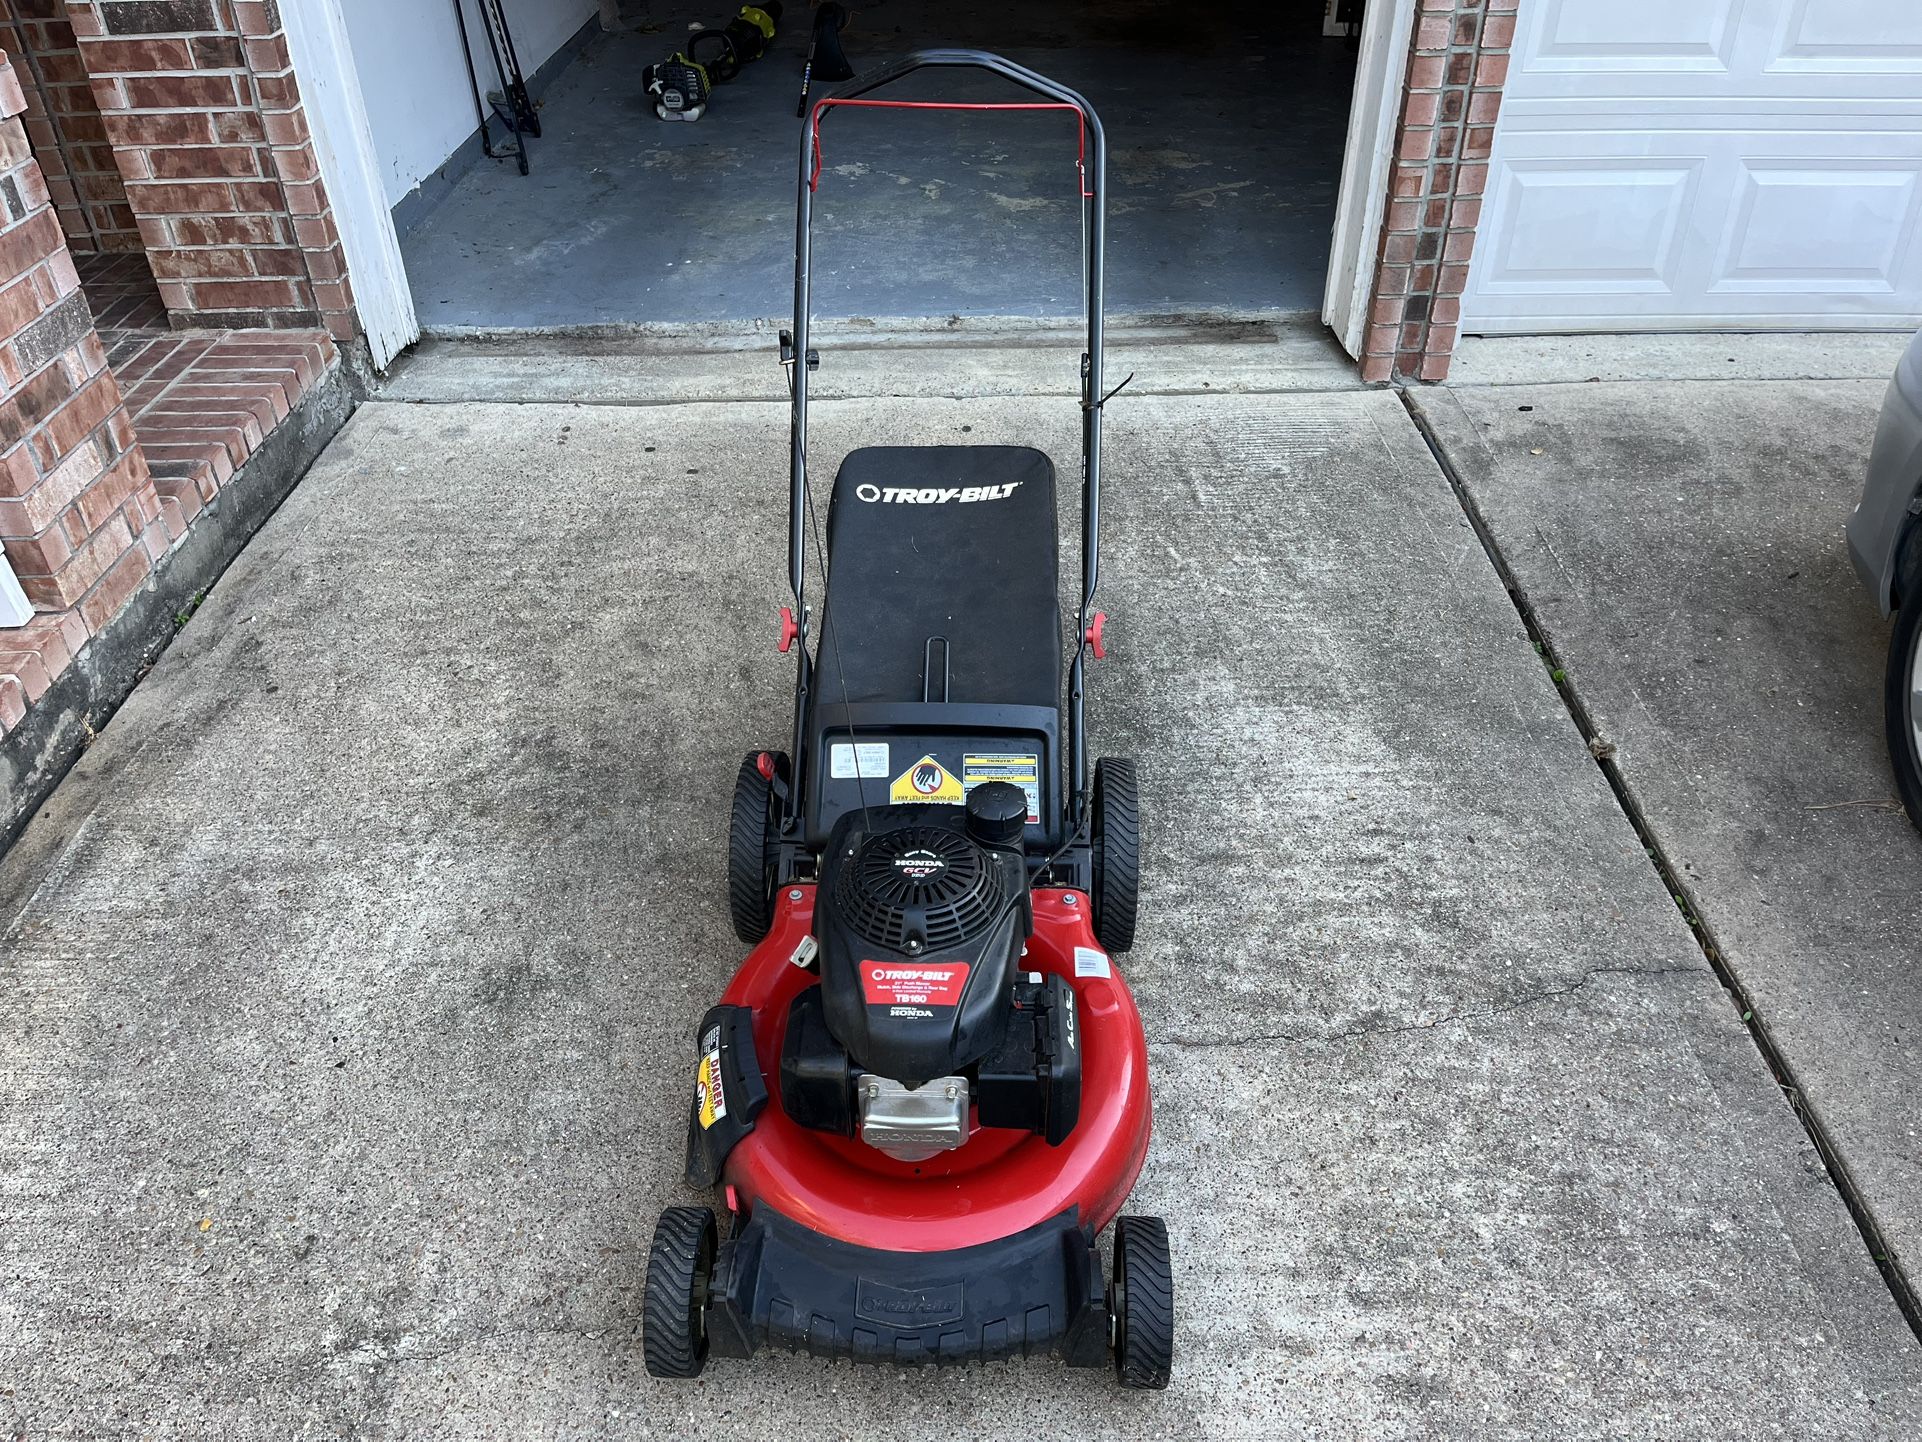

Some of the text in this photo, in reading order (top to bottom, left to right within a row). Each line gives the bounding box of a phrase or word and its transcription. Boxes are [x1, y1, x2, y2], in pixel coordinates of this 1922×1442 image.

[882, 481, 1020, 504] TROY-BILT
[884, 970, 954, 981] TROY-BILT
[895, 994, 927, 1003] TB160
[710, 1058, 723, 1109] DANGER
[870, 1133, 952, 1143] HONDA
